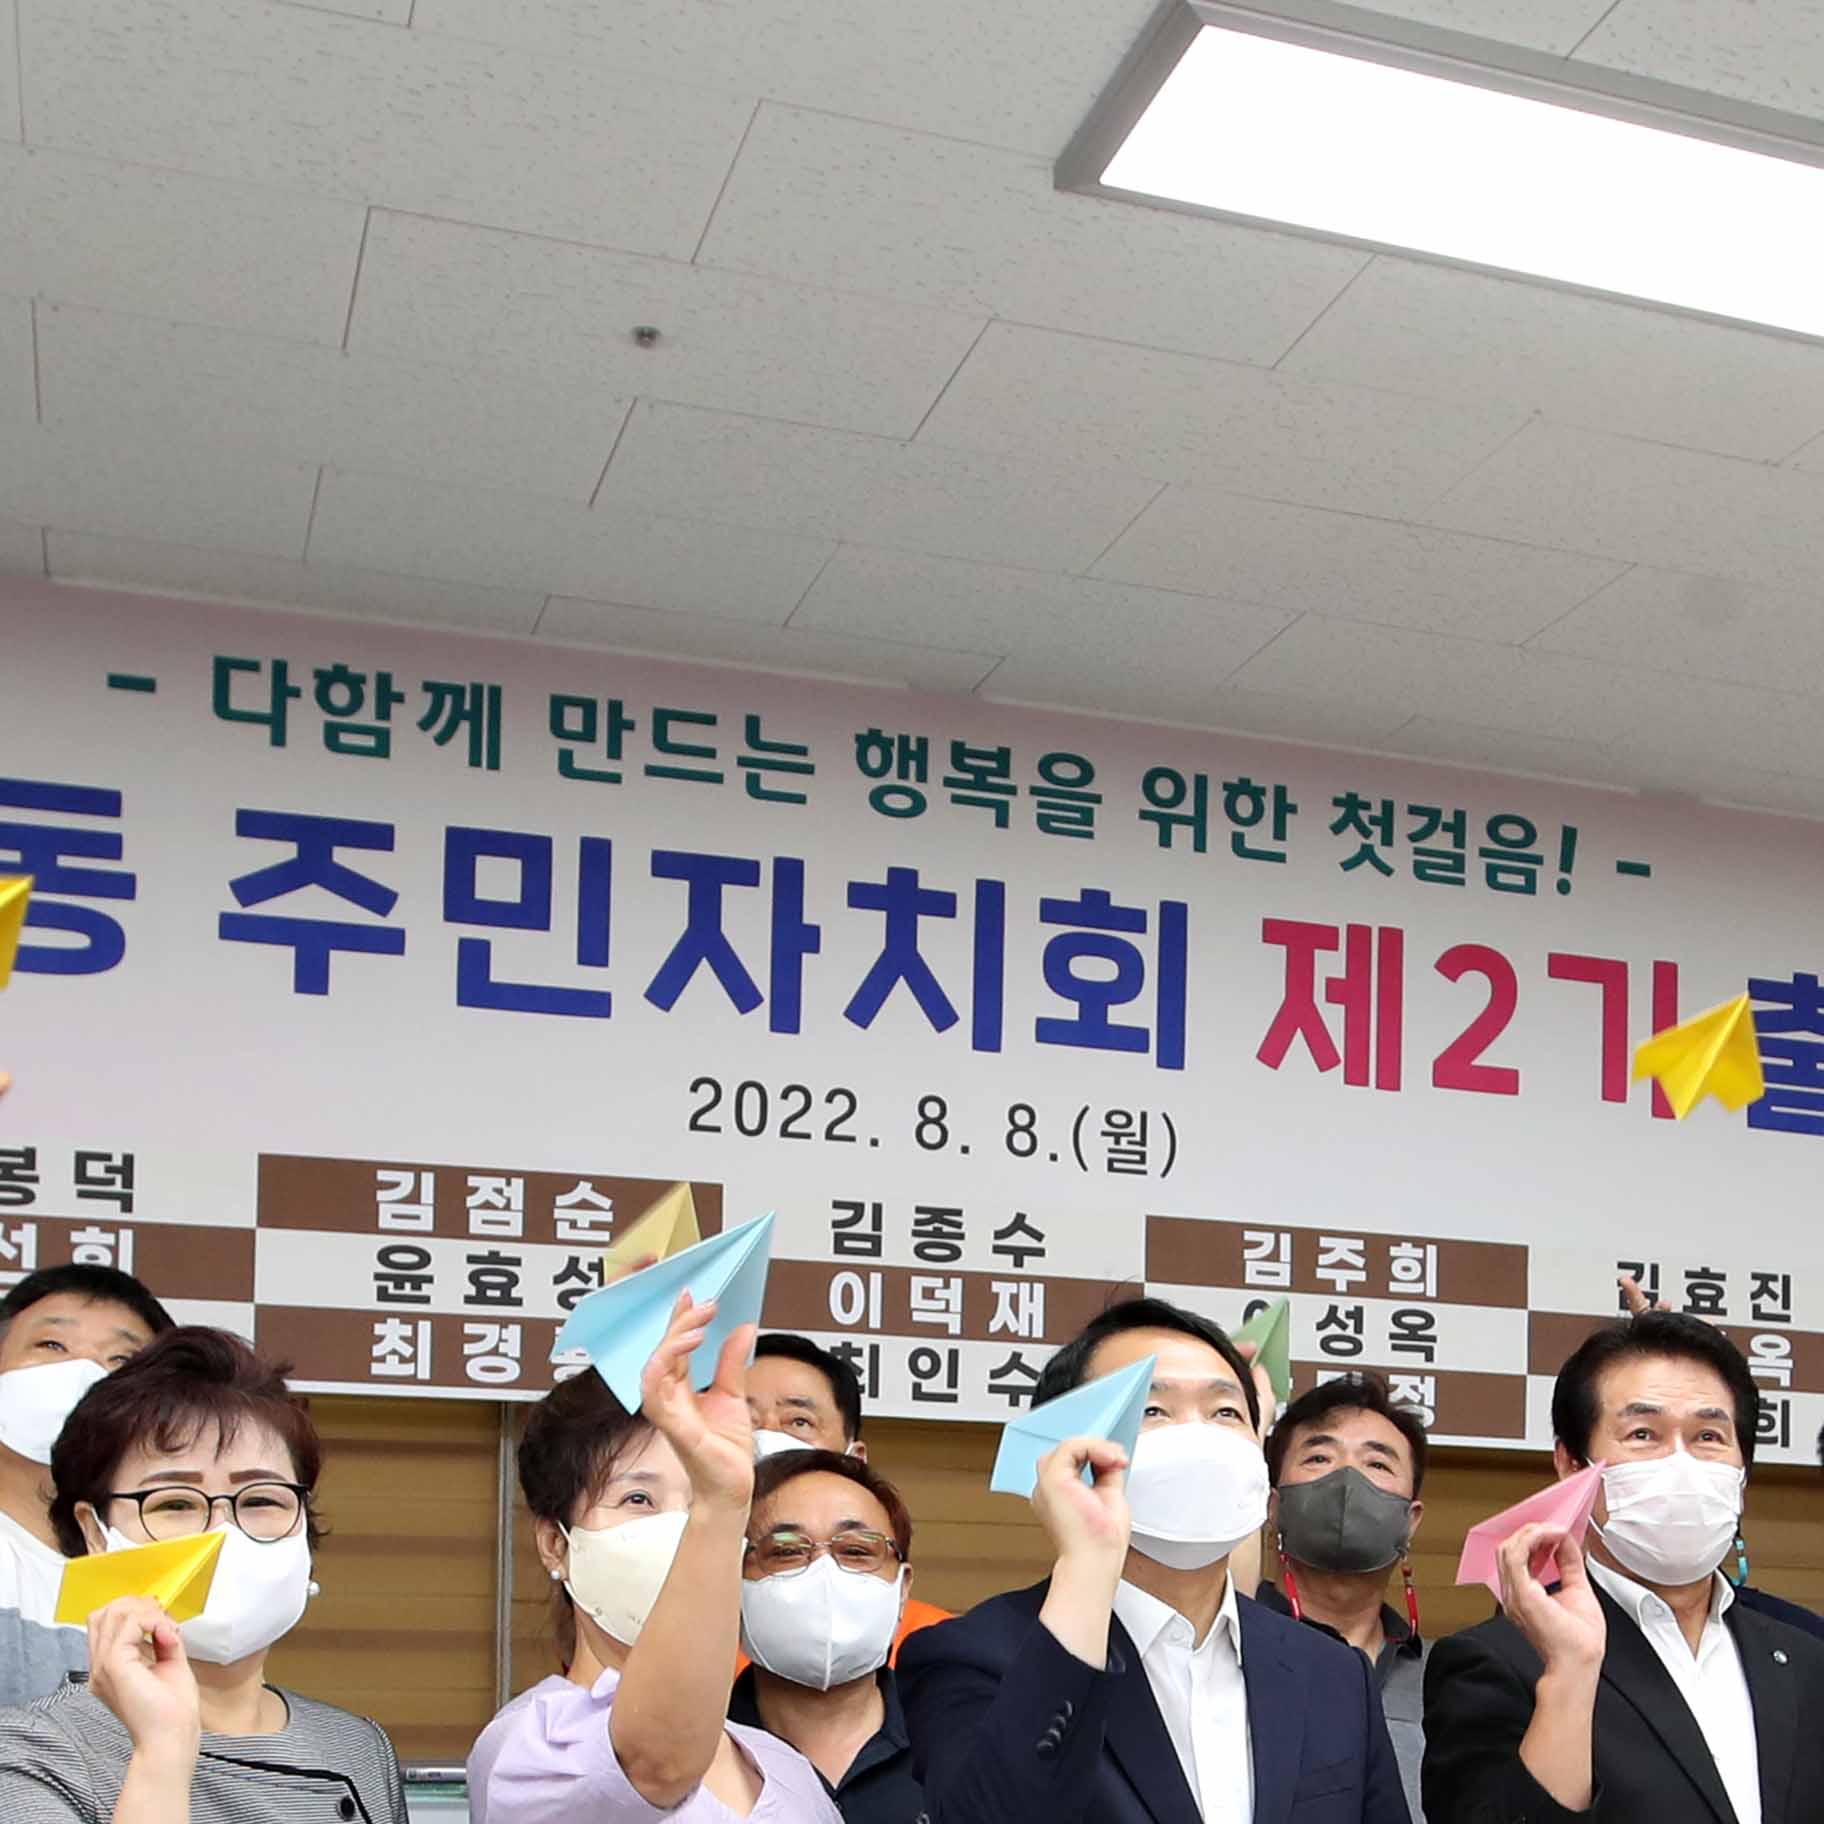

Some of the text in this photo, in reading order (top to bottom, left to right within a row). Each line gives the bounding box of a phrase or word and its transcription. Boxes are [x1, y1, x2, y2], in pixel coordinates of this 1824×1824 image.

[212, 655, 503, 771] 다함께
[549, 693, 816, 805] 만드는
[854, 727, 1103, 840] 행복을
[1138, 766, 1298, 864] 위한
[1328, 791, 1577, 897] 첫걸음!
[218, 807, 1188, 1070] 주민자치회
[1255, 917, 1679, 1121] 제2기
[688, 1076, 879, 1147] 2022.
[1242, 1299, 1438, 1363] 성옥
